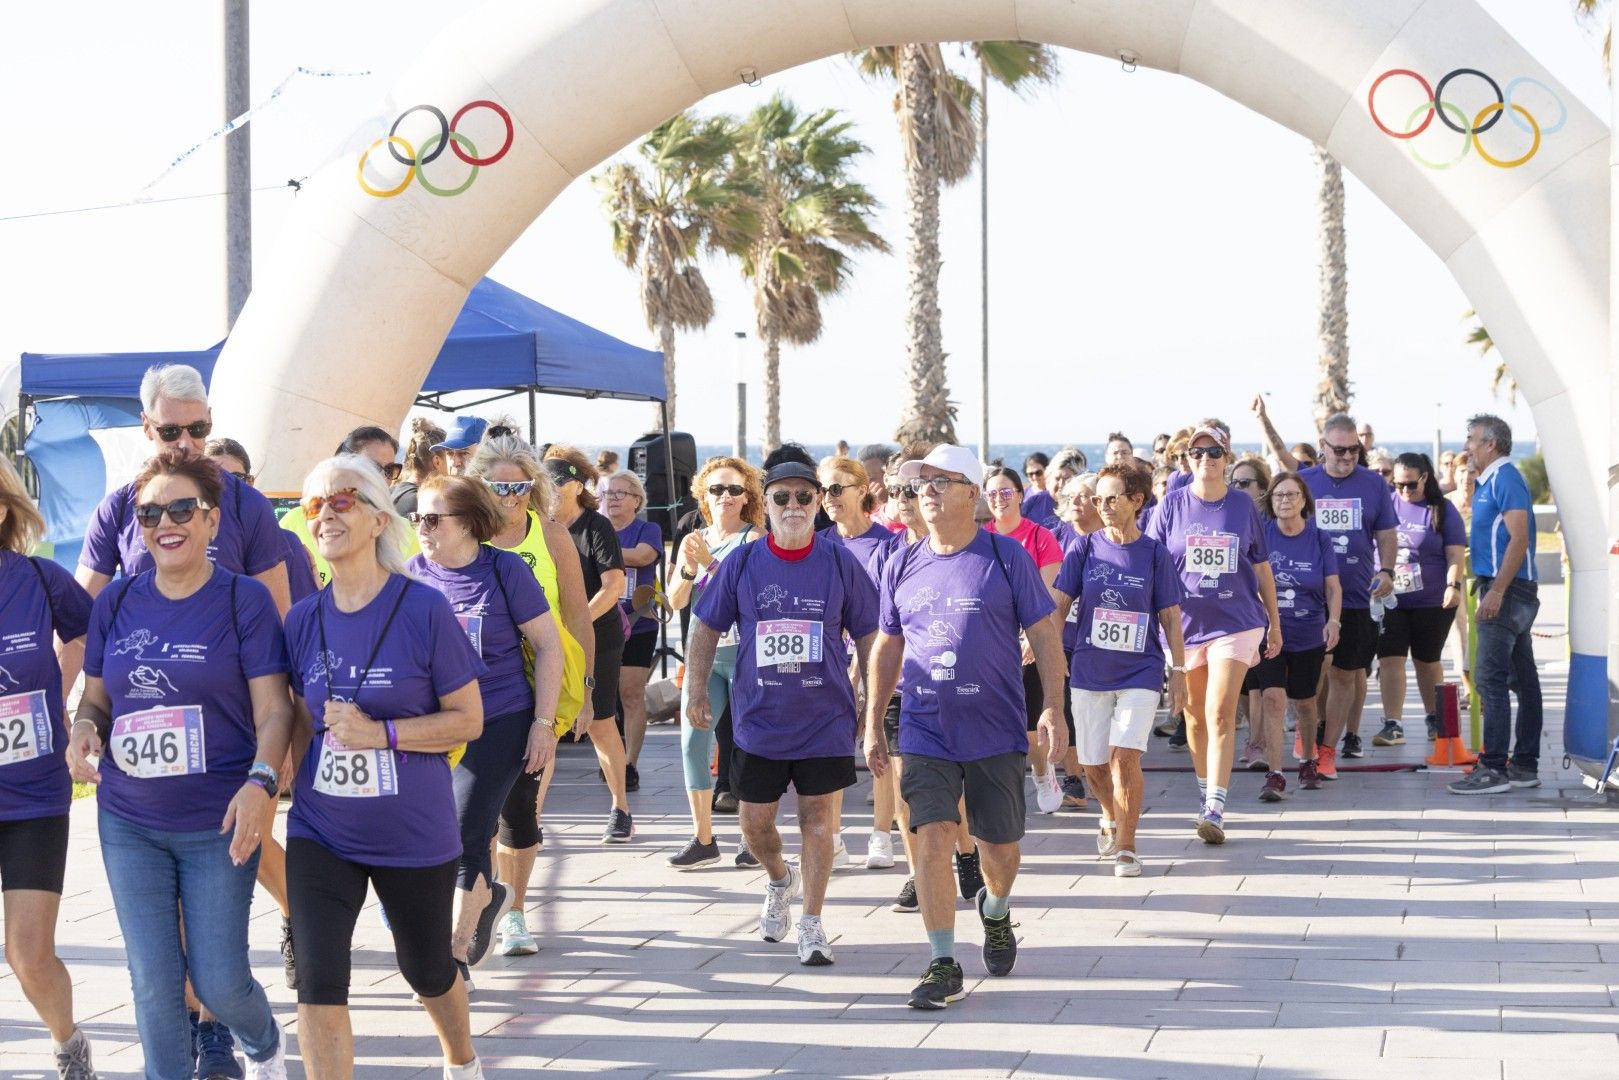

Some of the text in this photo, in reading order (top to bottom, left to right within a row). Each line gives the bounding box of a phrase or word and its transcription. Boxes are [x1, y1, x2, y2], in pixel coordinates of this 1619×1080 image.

[1321, 509, 1349, 525] 386
[1192, 547, 1225, 566] 385
[1396, 573, 1411, 587] 45
[764, 634, 804, 657] 388
[1098, 622, 1130, 643] 361
[0, 719, 29, 752] 62
[35, 712, 49, 752] MARCHA
[189, 727, 200, 769] MARCHA
[122, 731, 179, 767] 346
[321, 750, 370, 786] 358
[379, 749, 393, 791] MARCHA
